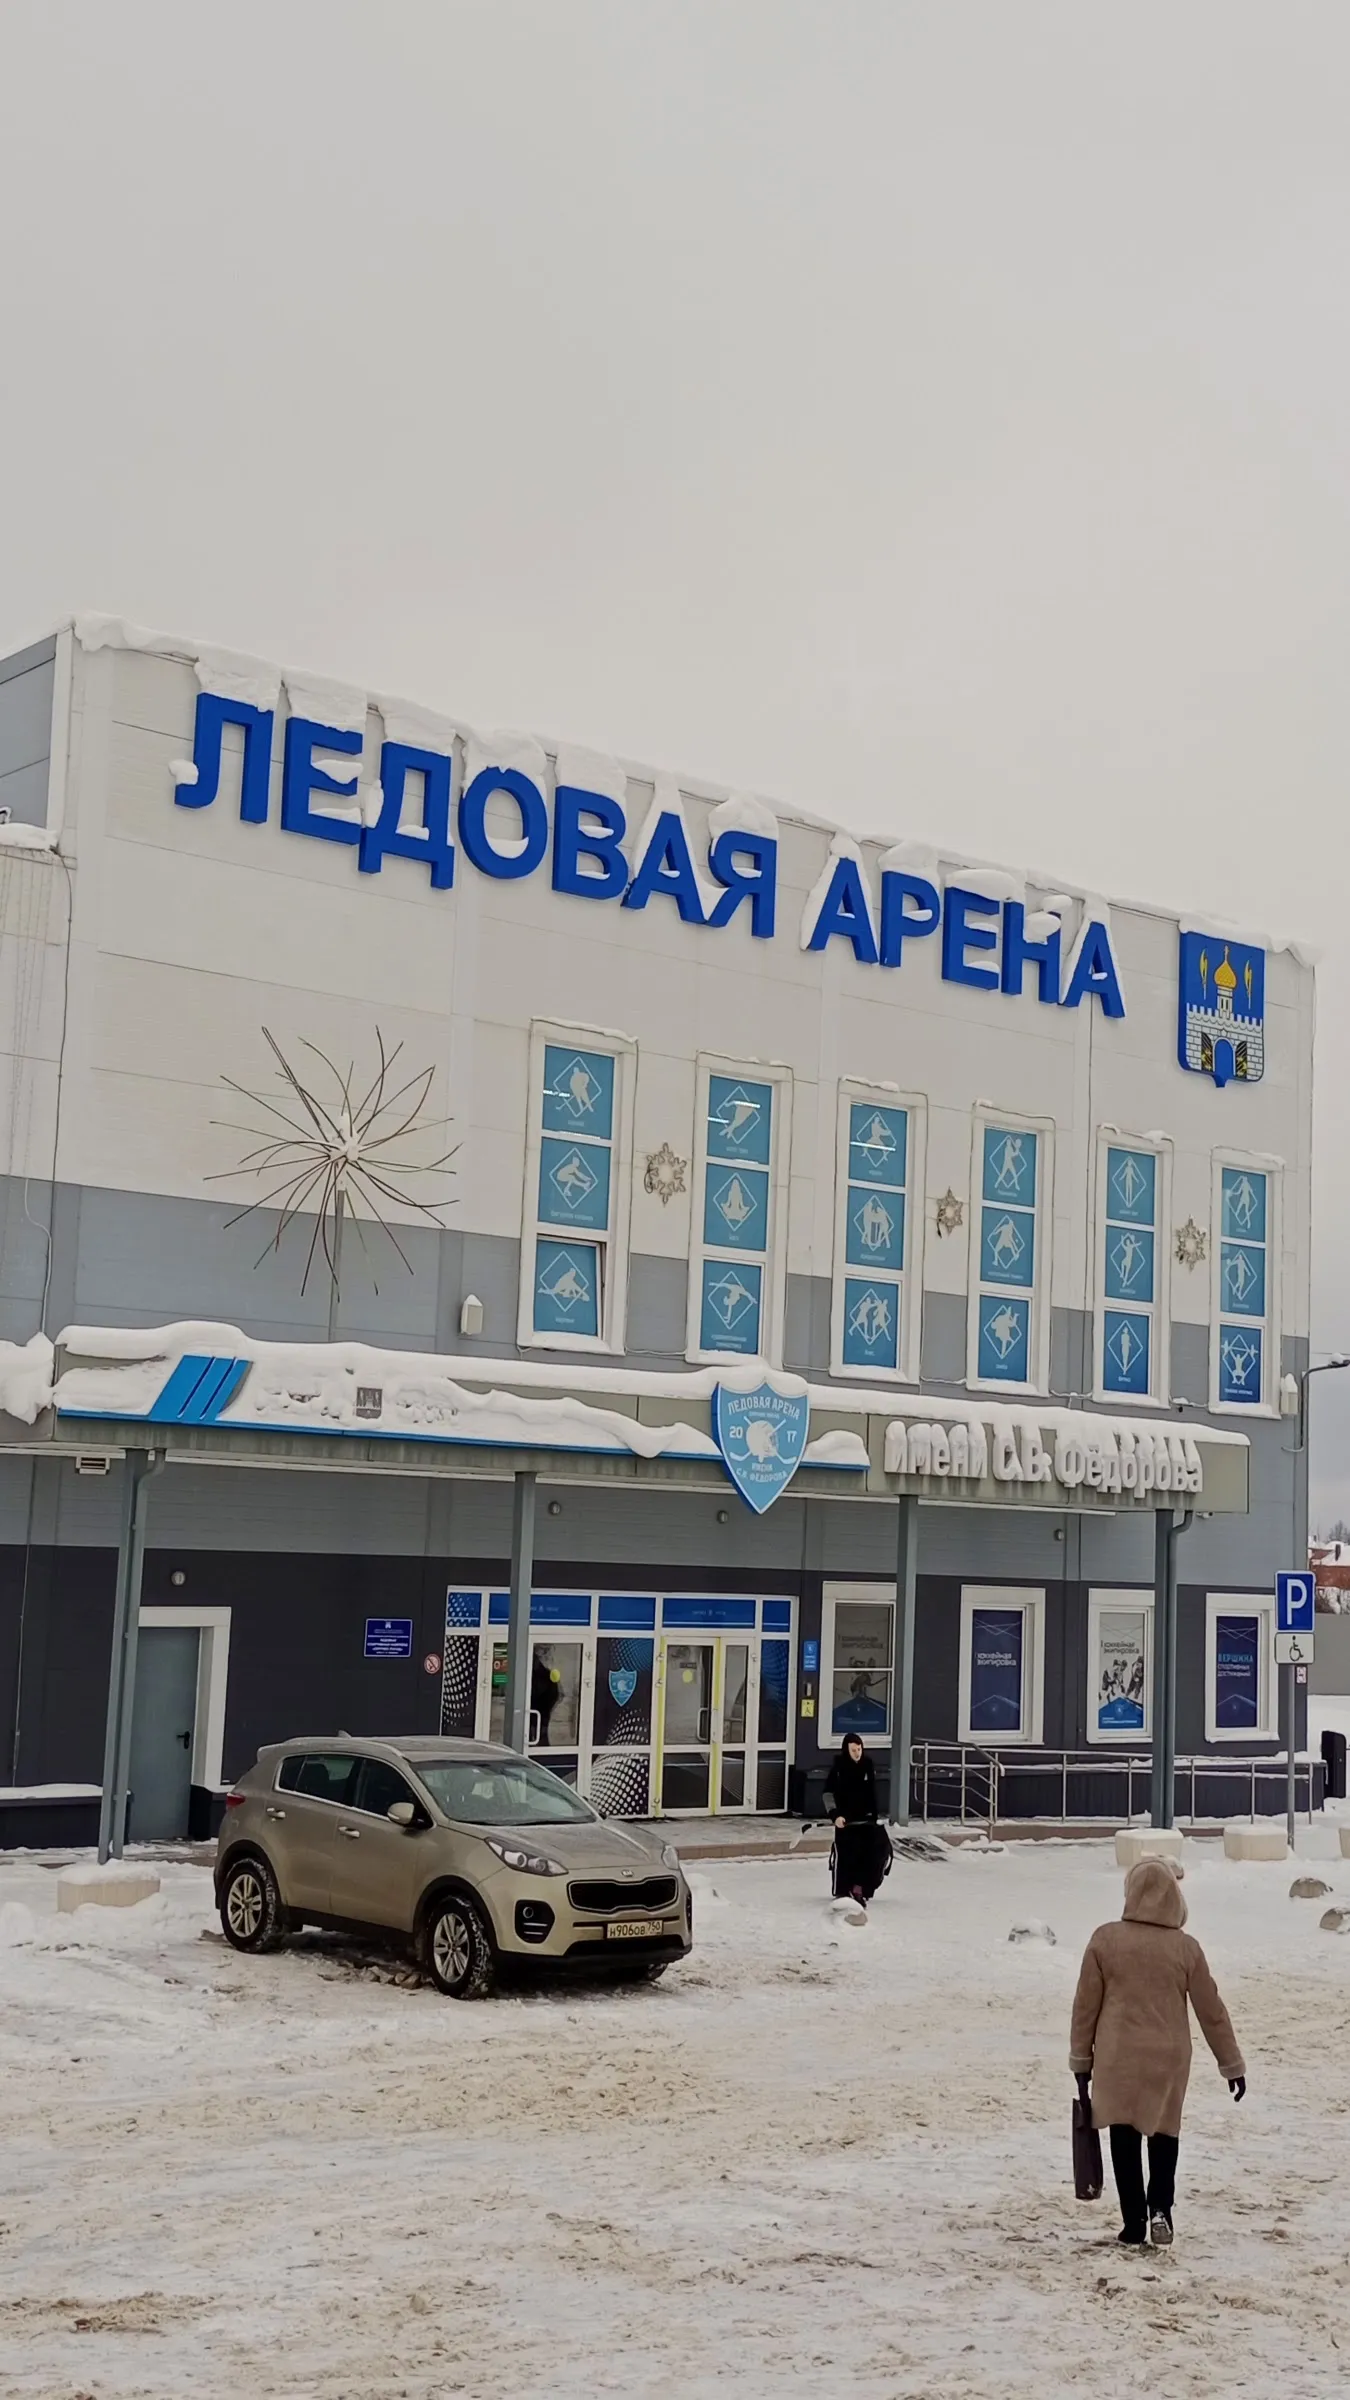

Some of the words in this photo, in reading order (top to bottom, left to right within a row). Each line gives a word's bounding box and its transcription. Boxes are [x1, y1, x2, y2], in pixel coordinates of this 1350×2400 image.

[174, 691, 779, 939] ЛЕДОВАЯ
[804, 856, 1126, 1019] АРЕНА
[728, 1396, 771, 1415] ЛЕДОВАЯ
[771, 1398, 800, 1420] АРЕНА
[729, 1425, 743, 1439] 20
[786, 1430, 798, 1443] 17
[1286, 1578, 1308, 1626] P
